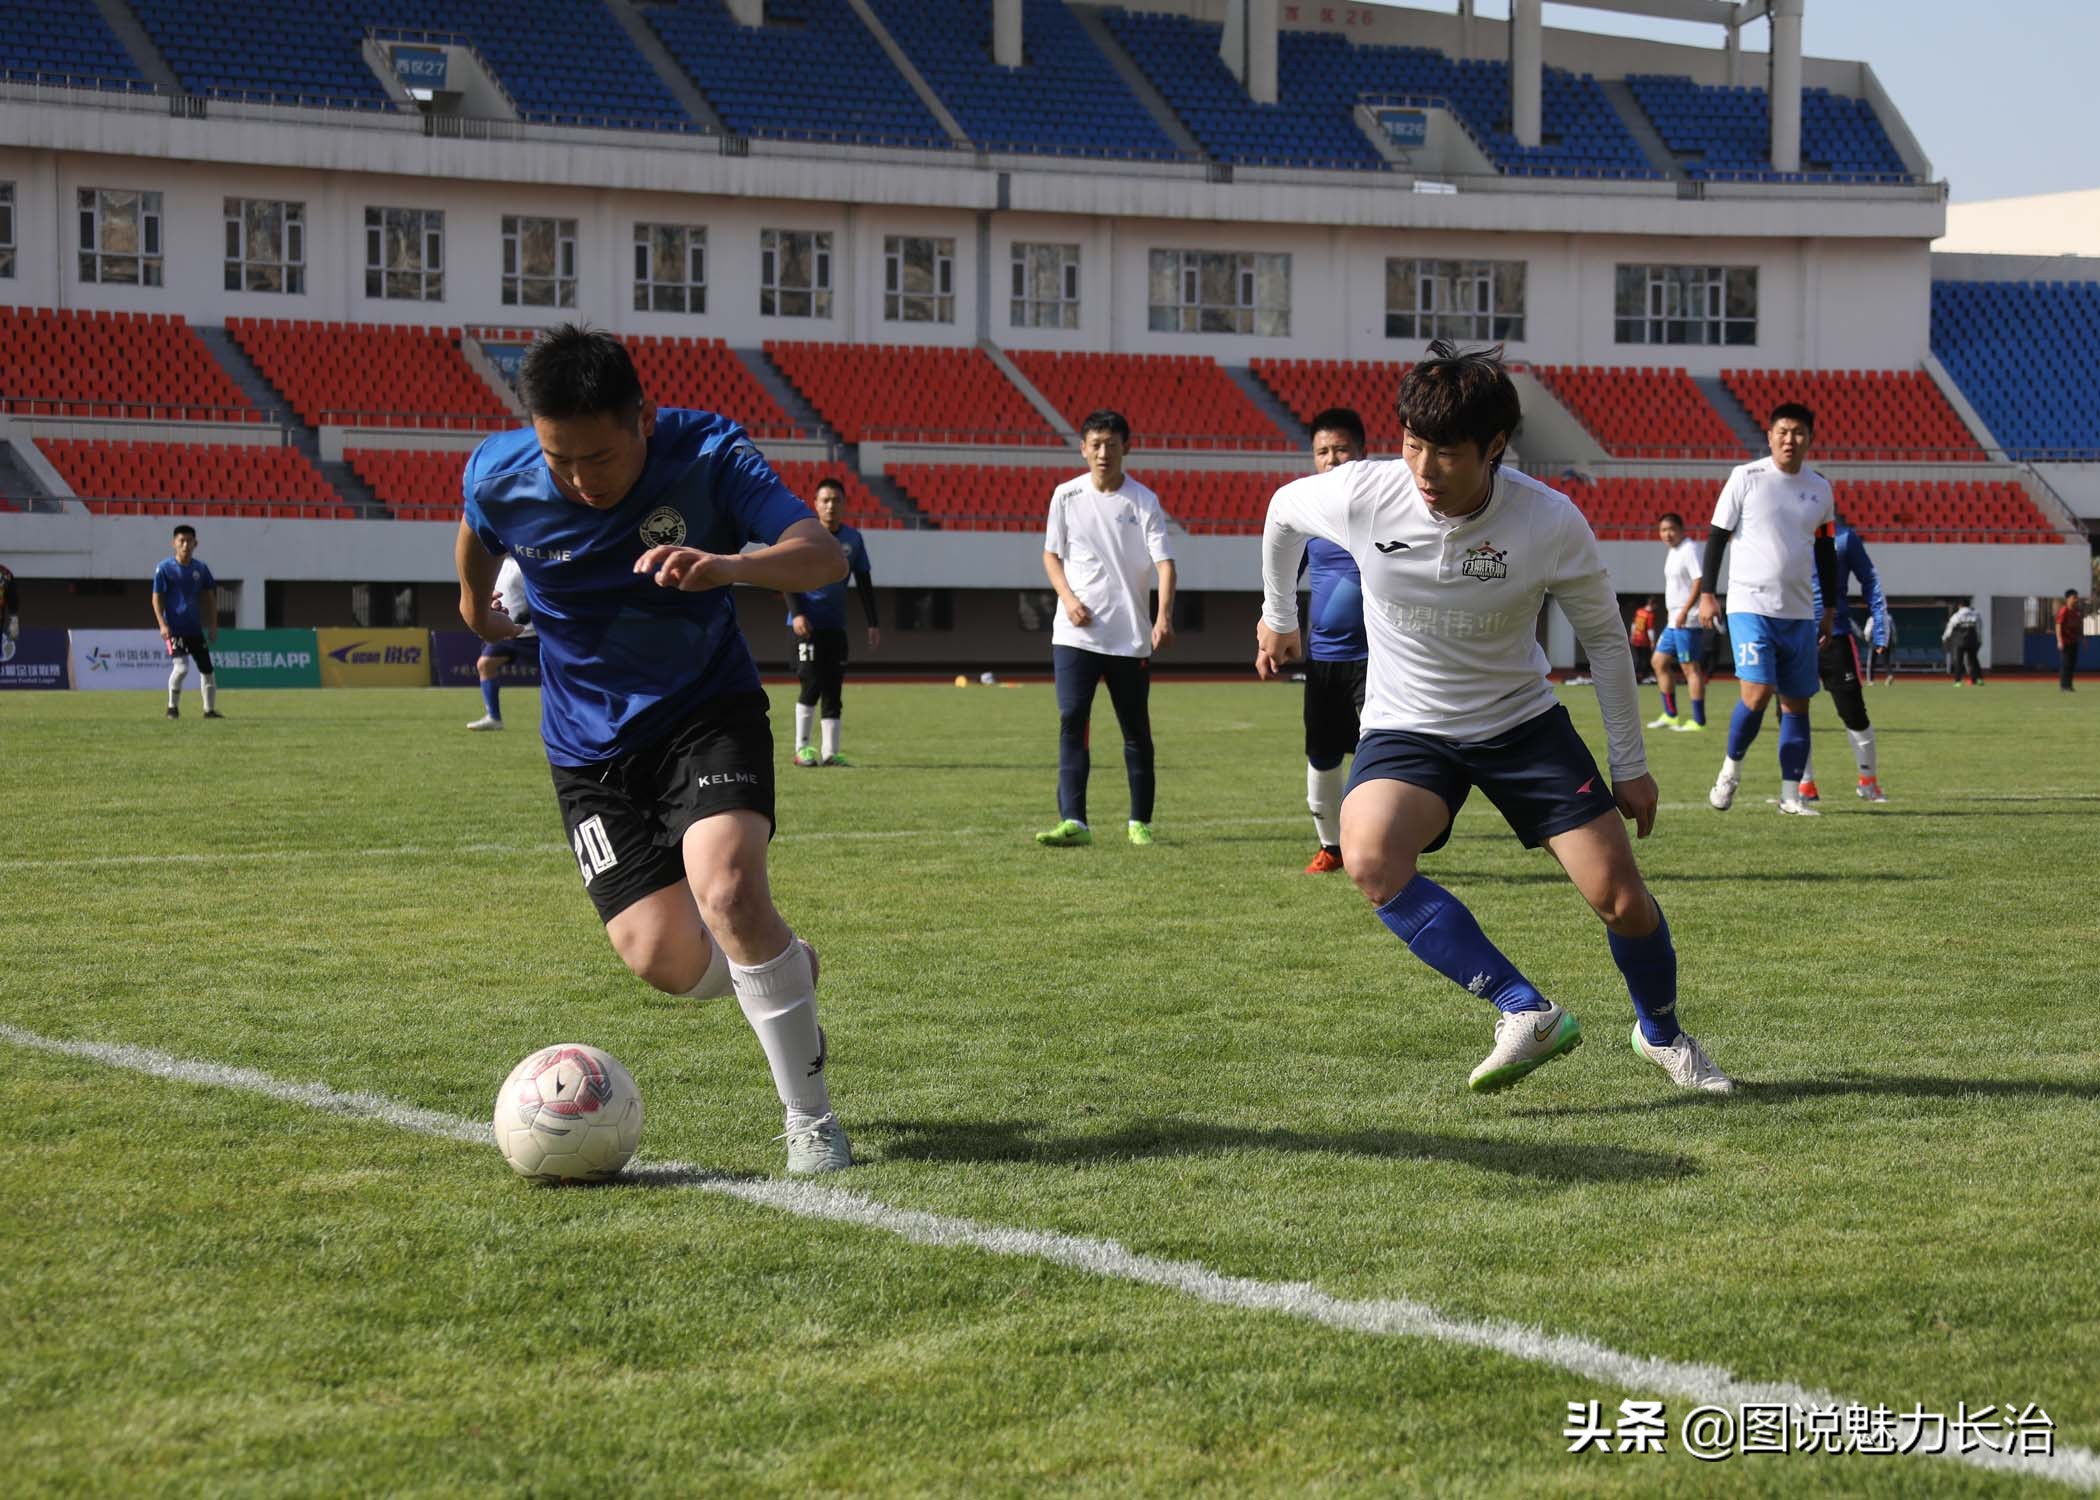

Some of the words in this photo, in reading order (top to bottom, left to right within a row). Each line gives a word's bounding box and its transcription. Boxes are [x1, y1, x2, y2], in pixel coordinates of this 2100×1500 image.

[514, 543, 572, 562] KELME
[798, 643, 815, 661] 21
[698, 772, 758, 788] KELME
[574, 814, 618, 887] 20
